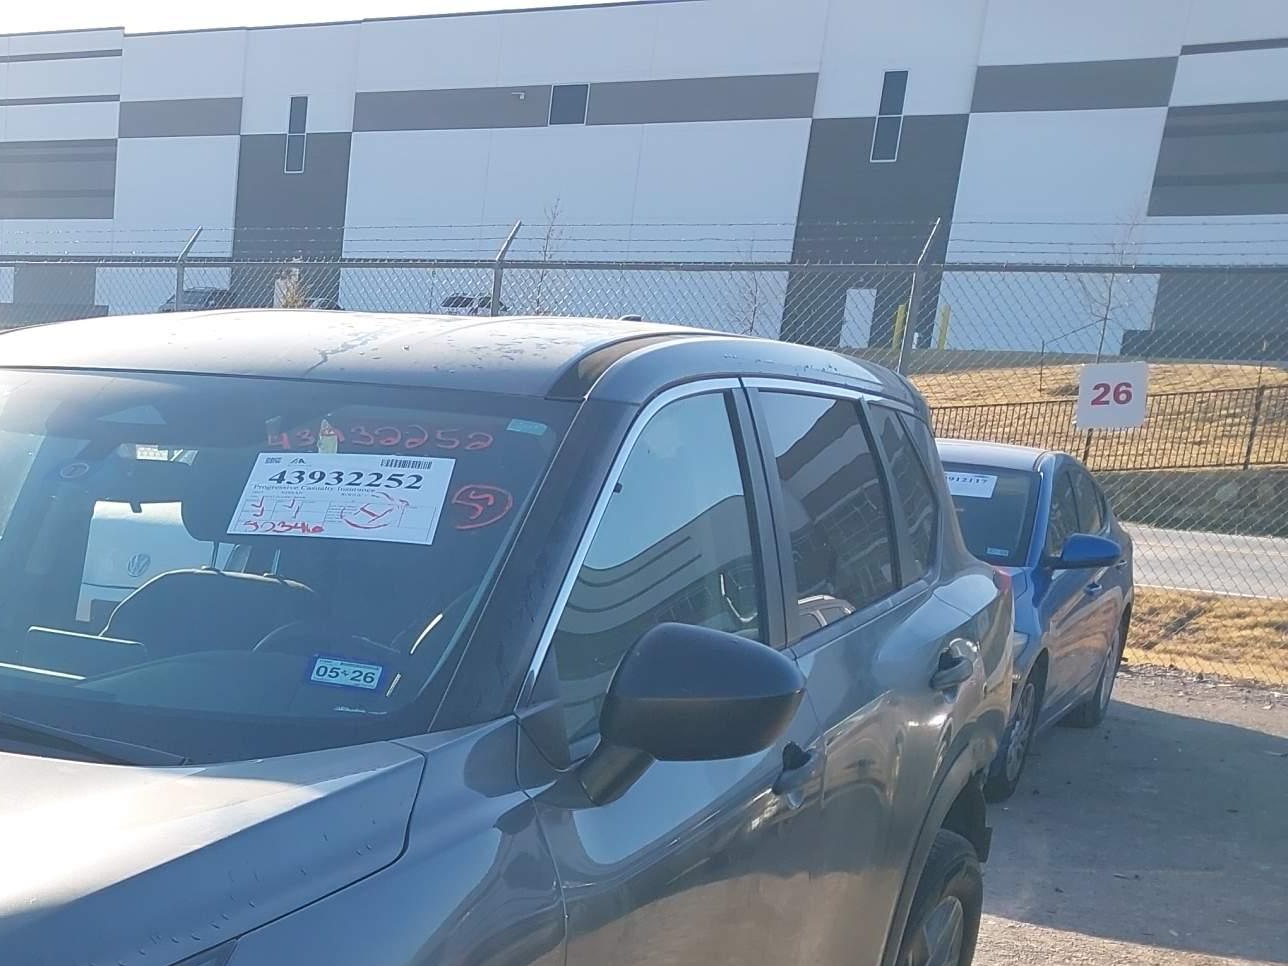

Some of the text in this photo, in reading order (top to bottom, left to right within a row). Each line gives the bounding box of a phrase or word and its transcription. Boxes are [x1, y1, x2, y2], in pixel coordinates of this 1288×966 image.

[1091, 382, 1133, 406] 26
[253, 483, 299, 491] Progressive
[268, 469, 424, 490] 43932252
[315, 665, 376, 684] 05 26
